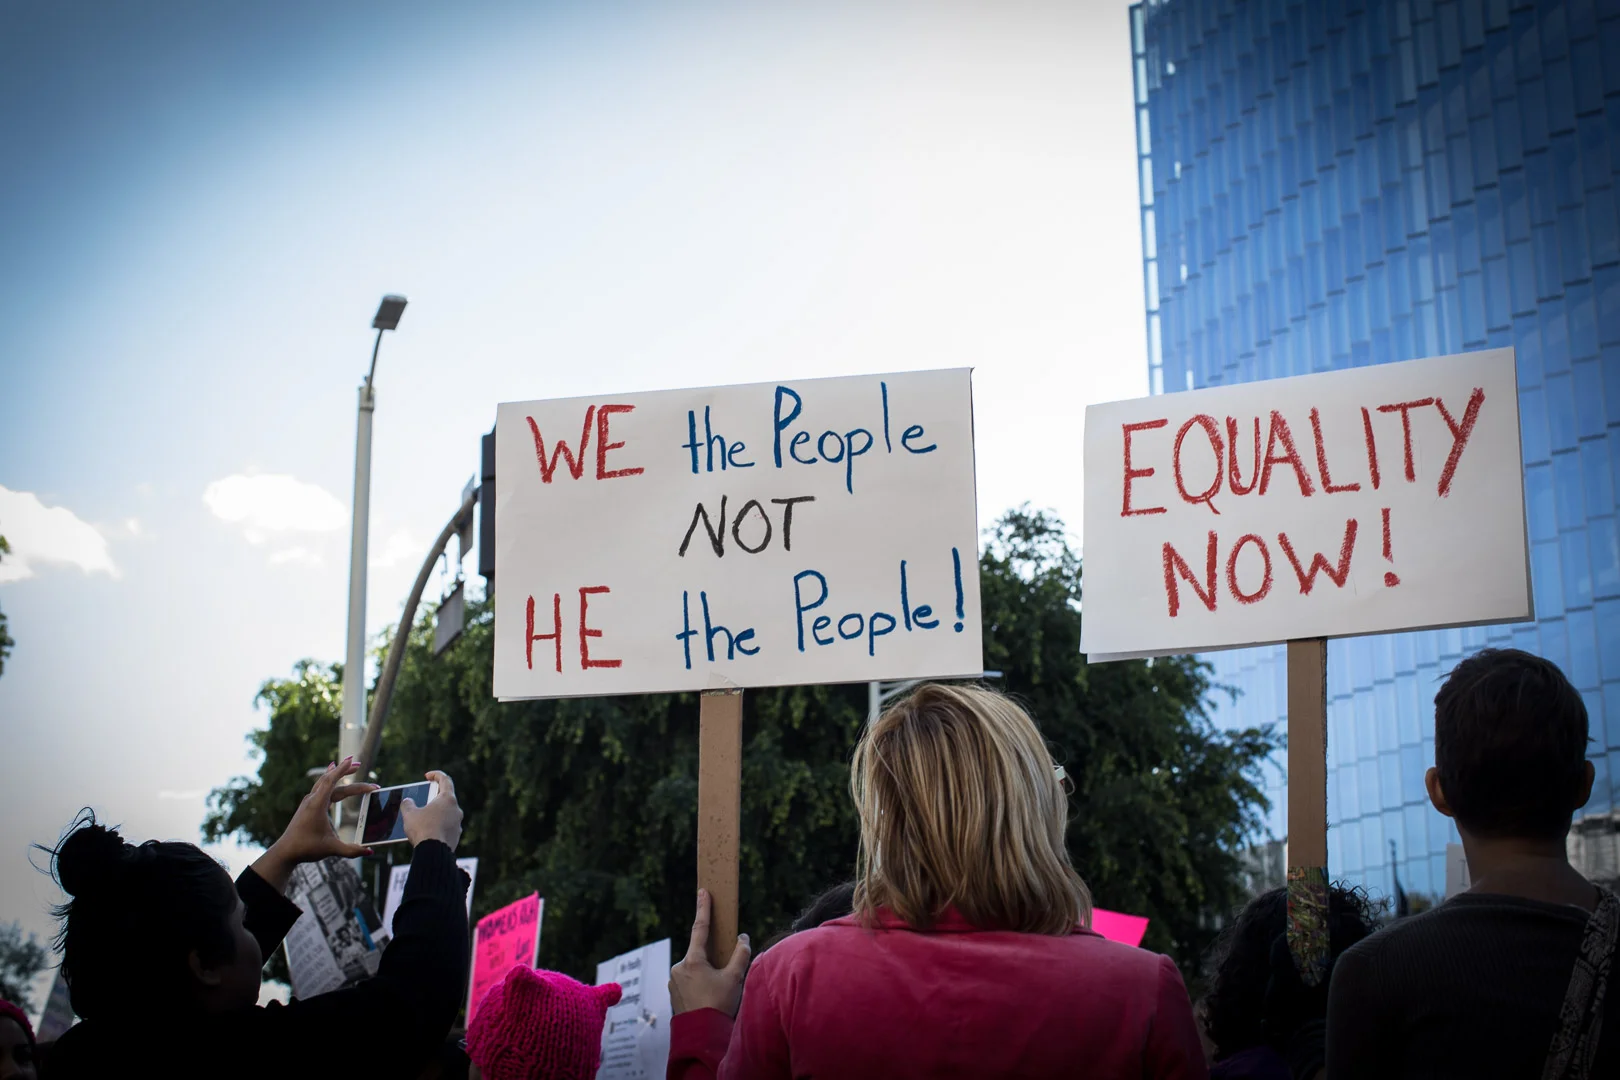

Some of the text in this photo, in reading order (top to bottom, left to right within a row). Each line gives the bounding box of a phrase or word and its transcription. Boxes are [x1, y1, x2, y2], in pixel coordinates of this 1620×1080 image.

[526, 381, 937, 494] WE the People
[1120, 387, 1486, 516] EQUALITY
[678, 494, 815, 558] NOT
[1161, 506, 1401, 618] NOW!
[525, 547, 965, 673] HE the People!
